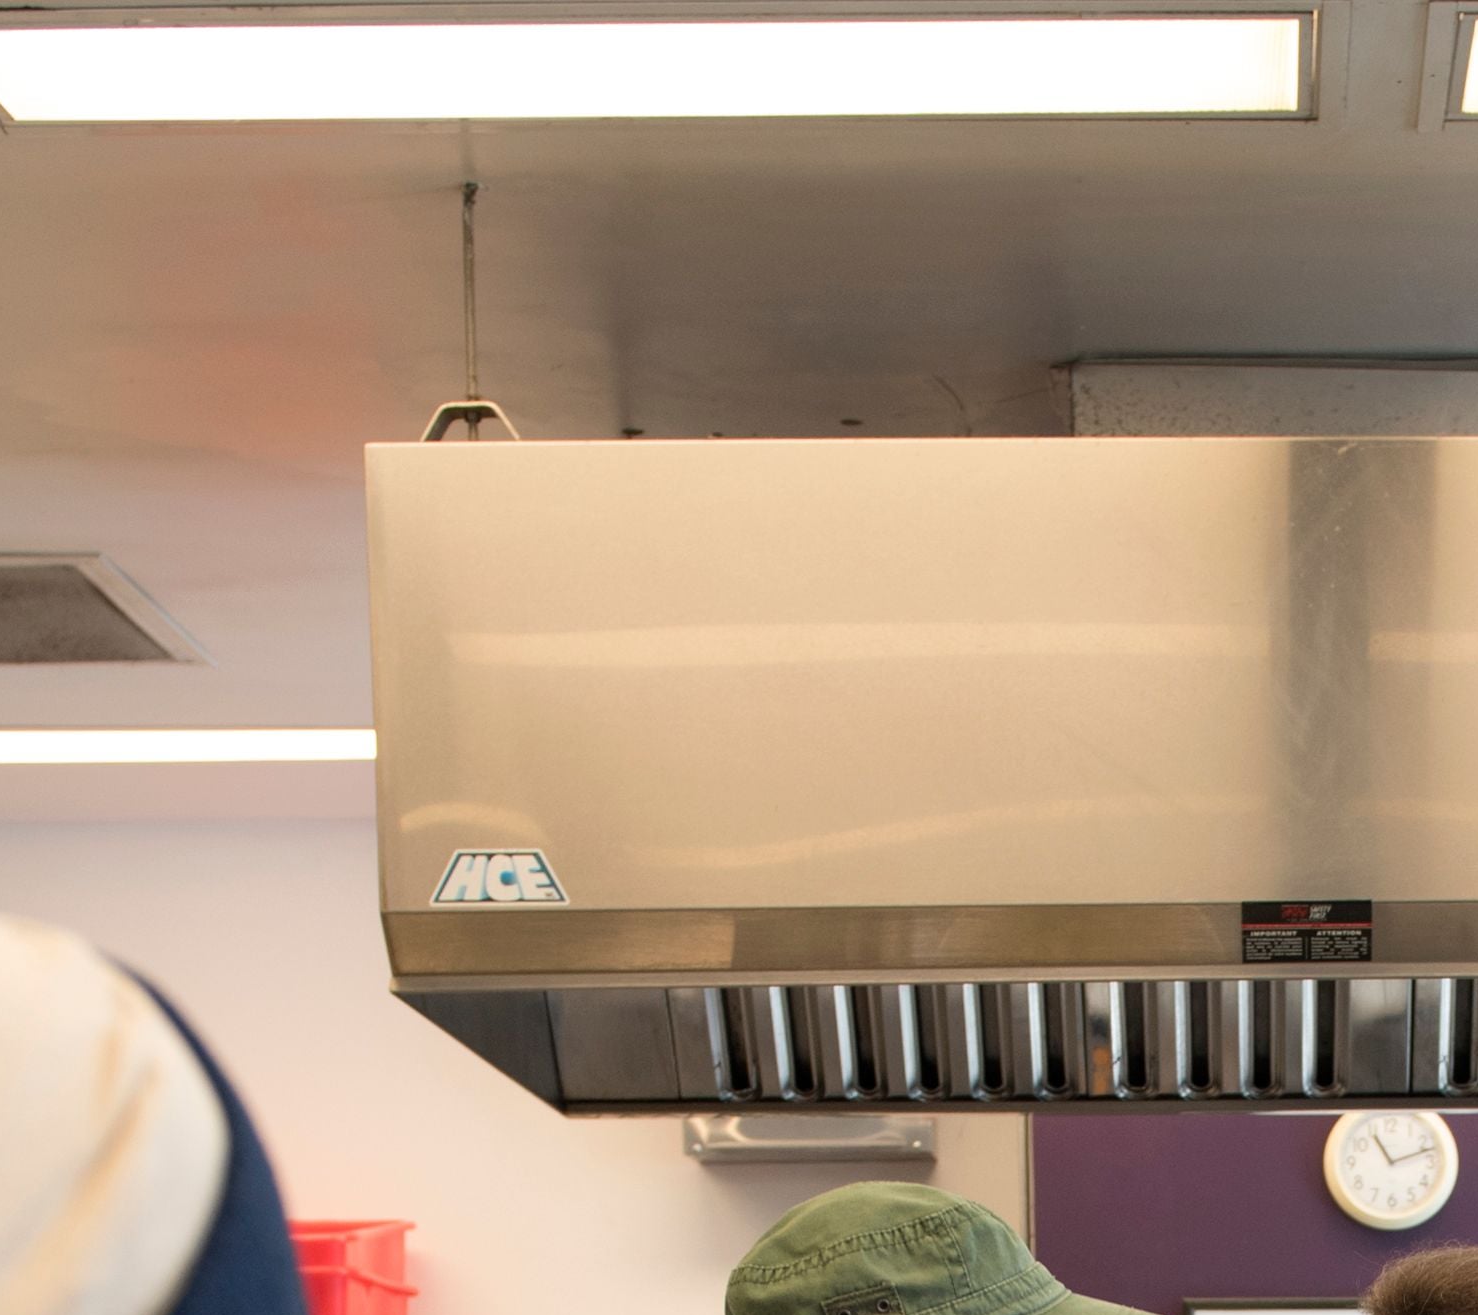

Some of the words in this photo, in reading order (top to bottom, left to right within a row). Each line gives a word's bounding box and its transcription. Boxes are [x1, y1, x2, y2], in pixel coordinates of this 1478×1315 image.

[437, 854, 563, 901] HCE
[1384, 1117, 1398, 1133] 12
[1353, 1137, 1368, 1153] 10
[1417, 1133, 1428, 1150] 2
[1346, 1155, 1356, 1171] 9
[1426, 1154, 1435, 1170] 3
[1354, 1174, 1364, 1190] 8
[1419, 1174, 1429, 1188] 4
[1370, 1187, 1380, 1201] 7
[1386, 1193, 1397, 1208] 6
[1407, 1186, 1416, 1202] 5
